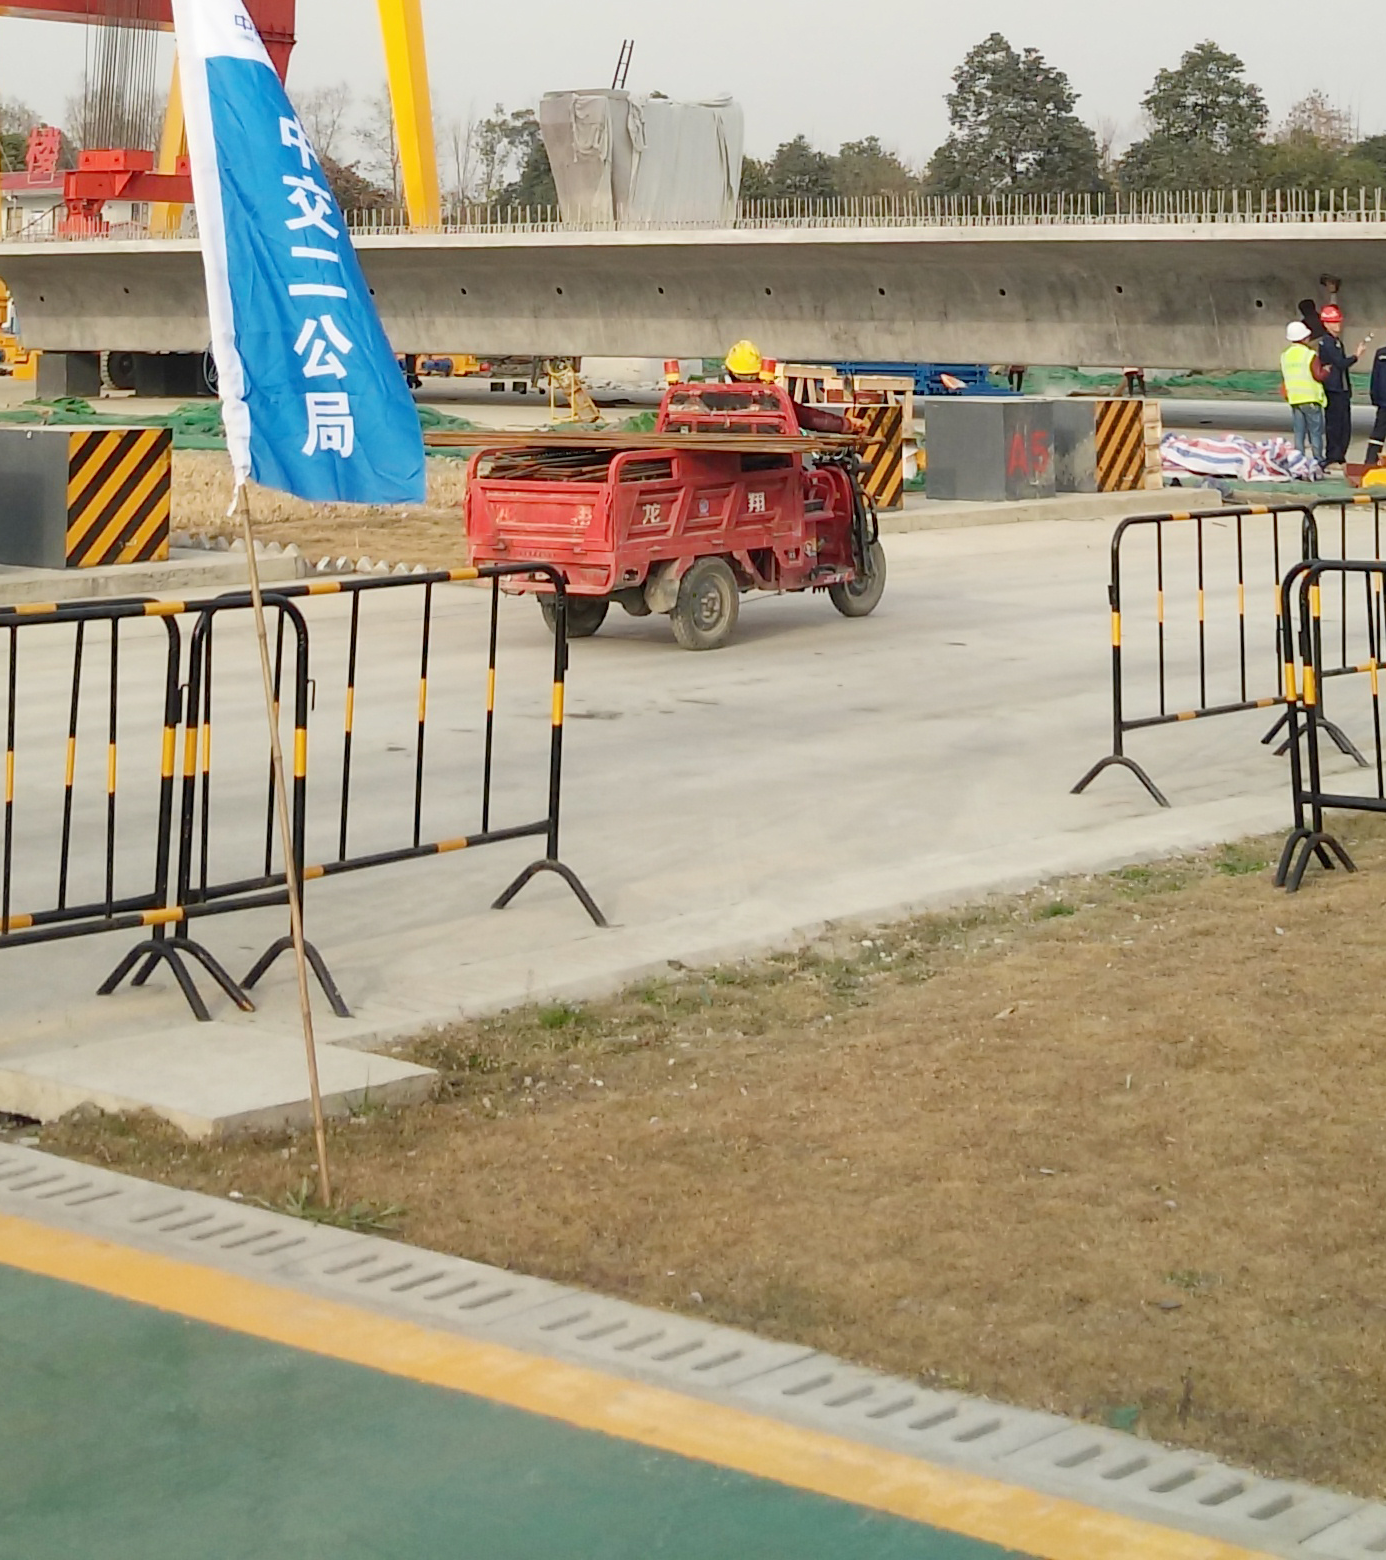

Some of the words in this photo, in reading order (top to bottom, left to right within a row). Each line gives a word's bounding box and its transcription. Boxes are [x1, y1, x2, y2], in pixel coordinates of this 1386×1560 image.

[278, 115, 355, 458] 中交二公局
[1006, 429, 1049, 477] A5
